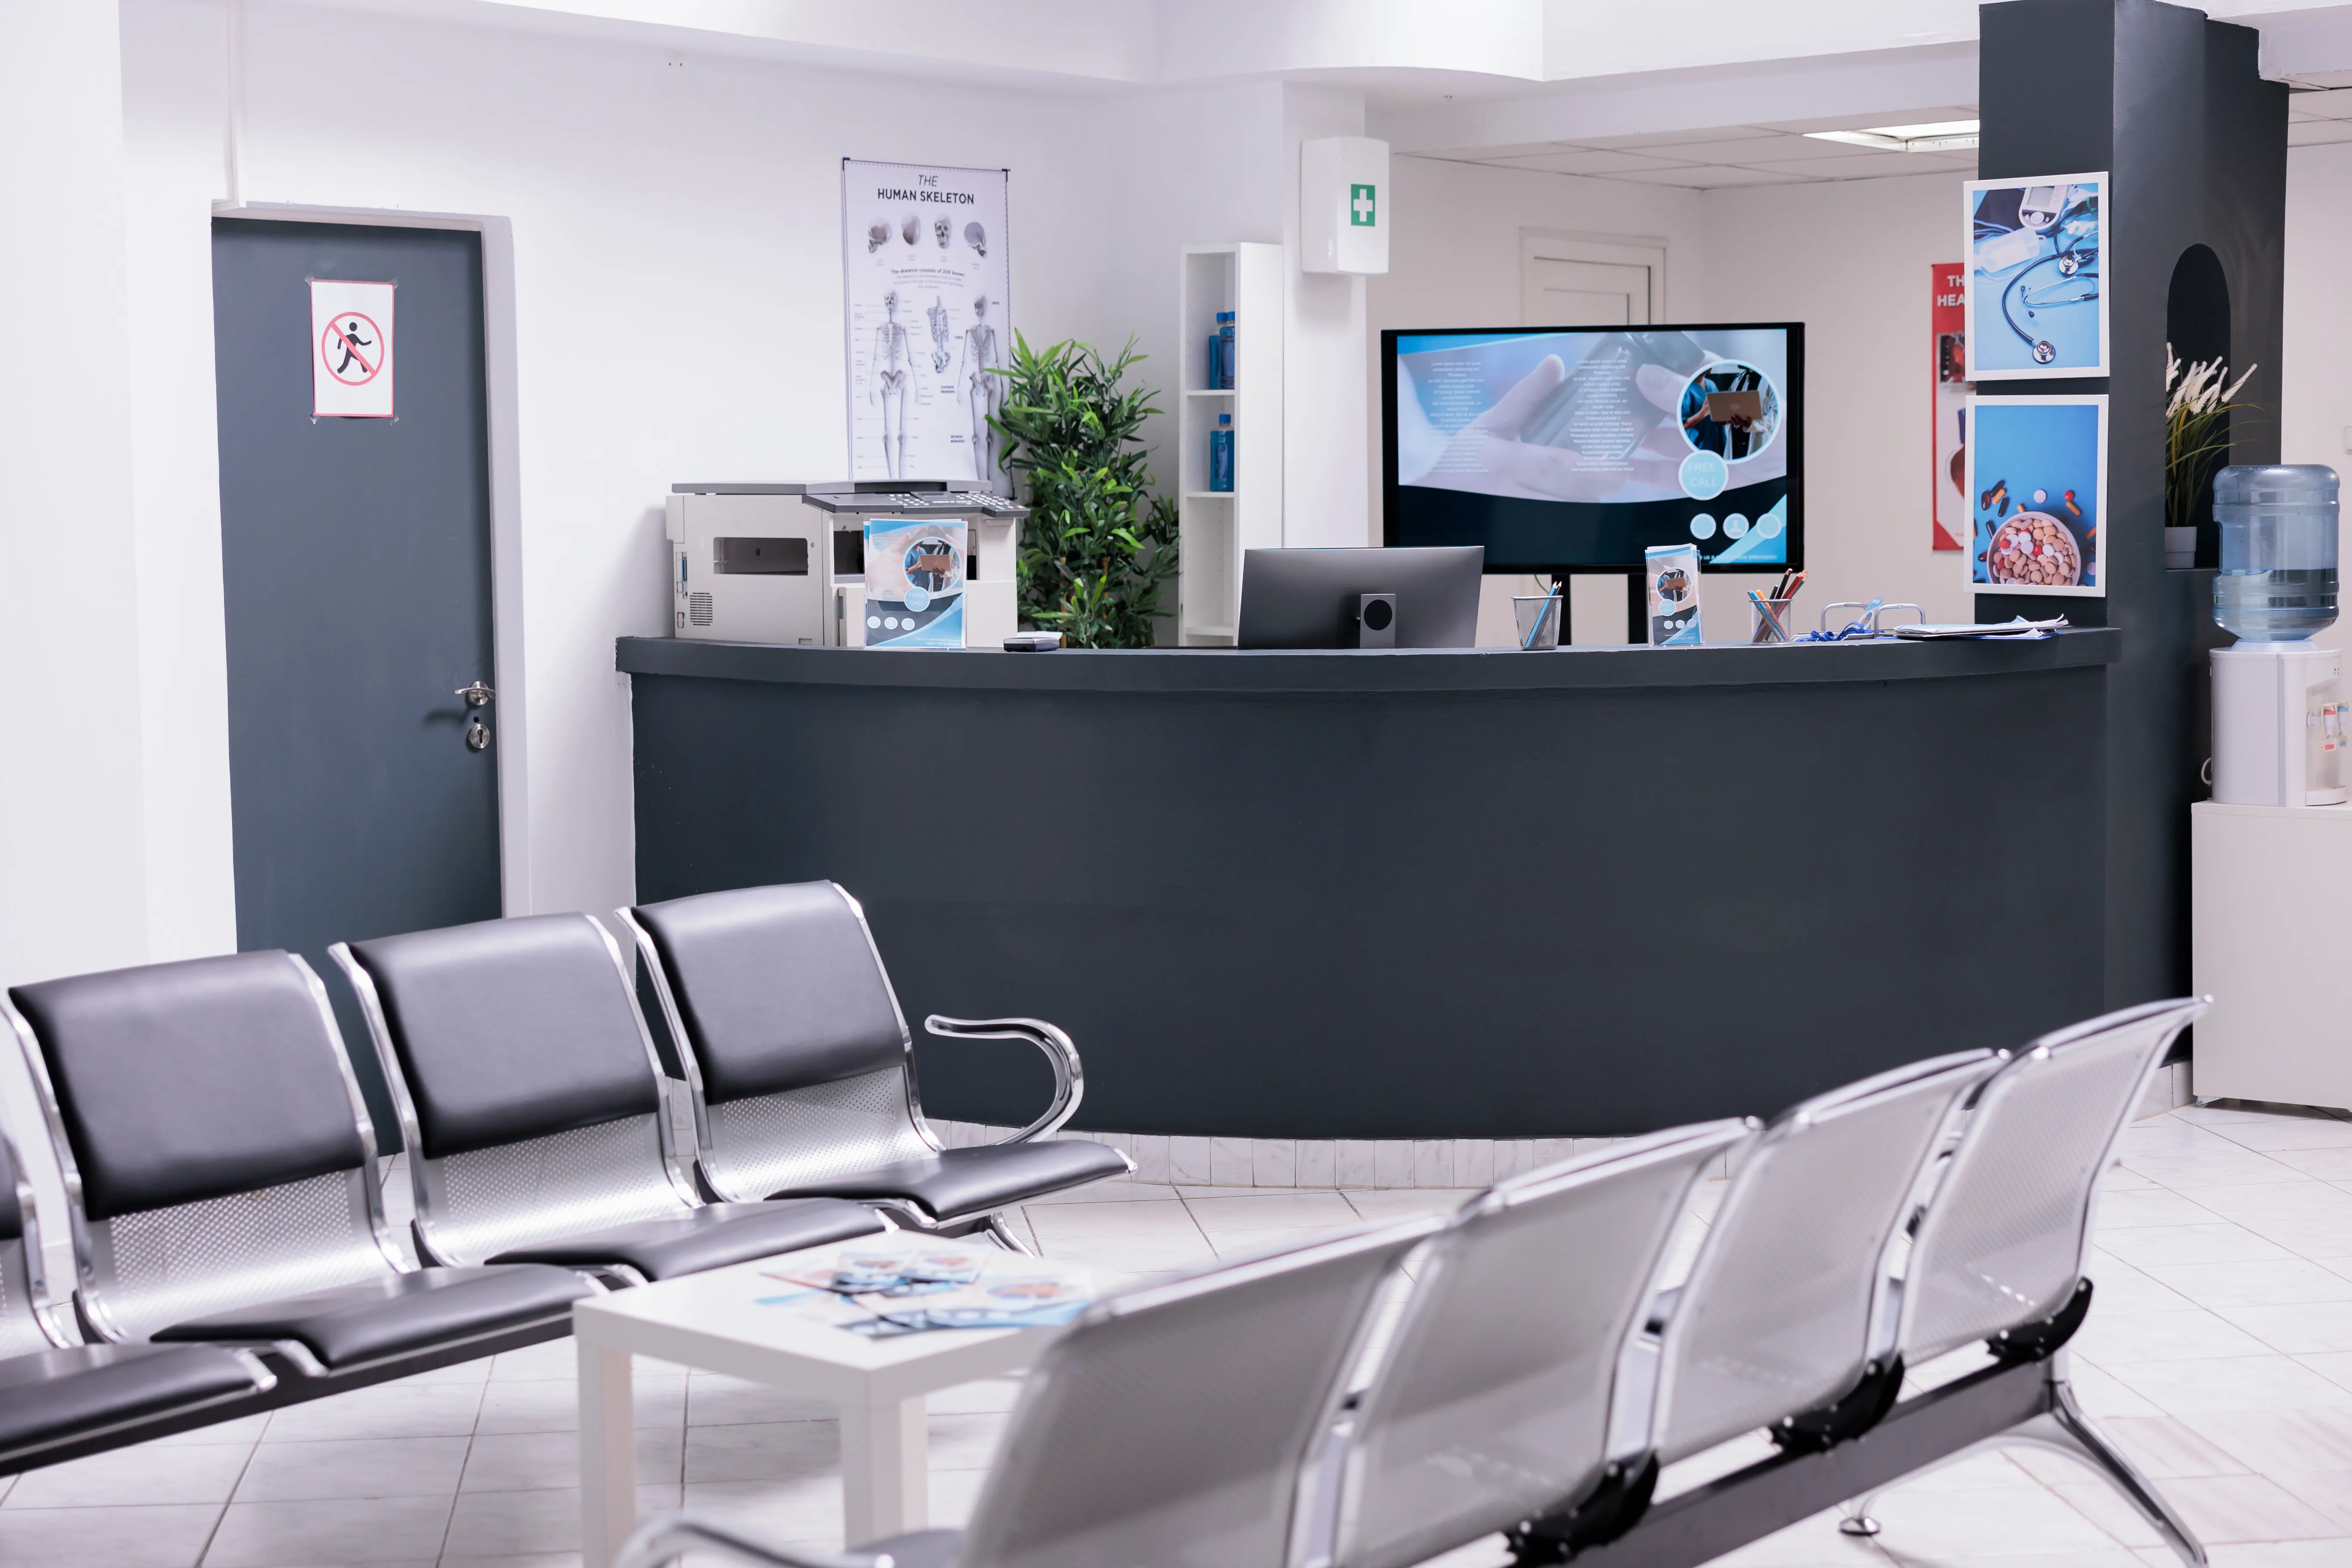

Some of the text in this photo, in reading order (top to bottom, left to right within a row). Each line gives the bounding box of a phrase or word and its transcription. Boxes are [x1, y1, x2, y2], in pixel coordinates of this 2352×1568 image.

[919, 175, 938, 187] THE
[878, 188, 974, 205] HUMAN SKELETON
[1937, 293, 1964, 307] HEA
[1688, 462, 1717, 472] FREE
[1690, 478, 1717, 487] CALL
